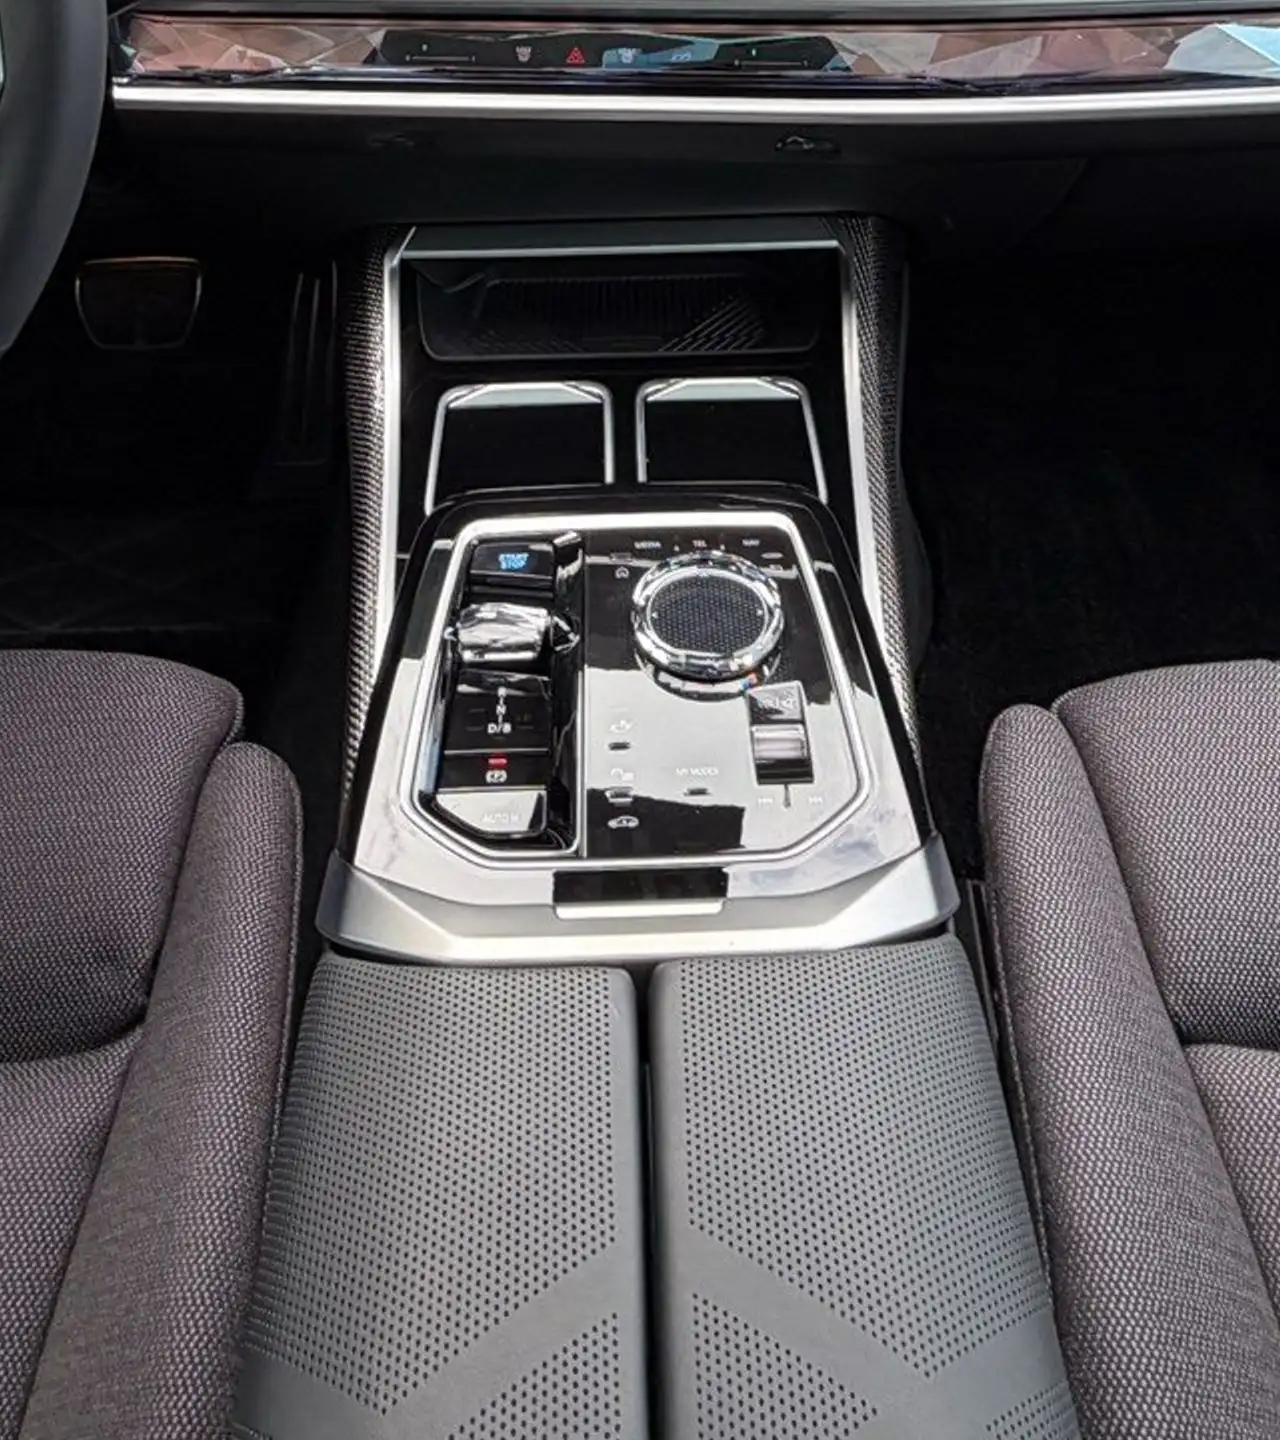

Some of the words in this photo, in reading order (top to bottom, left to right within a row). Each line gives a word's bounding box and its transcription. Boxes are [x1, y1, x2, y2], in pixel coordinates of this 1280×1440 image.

[499, 553, 530, 562] START
[500, 561, 527, 570] STOP
[495, 704, 506, 715] N
[487, 722, 511, 734] D/B
